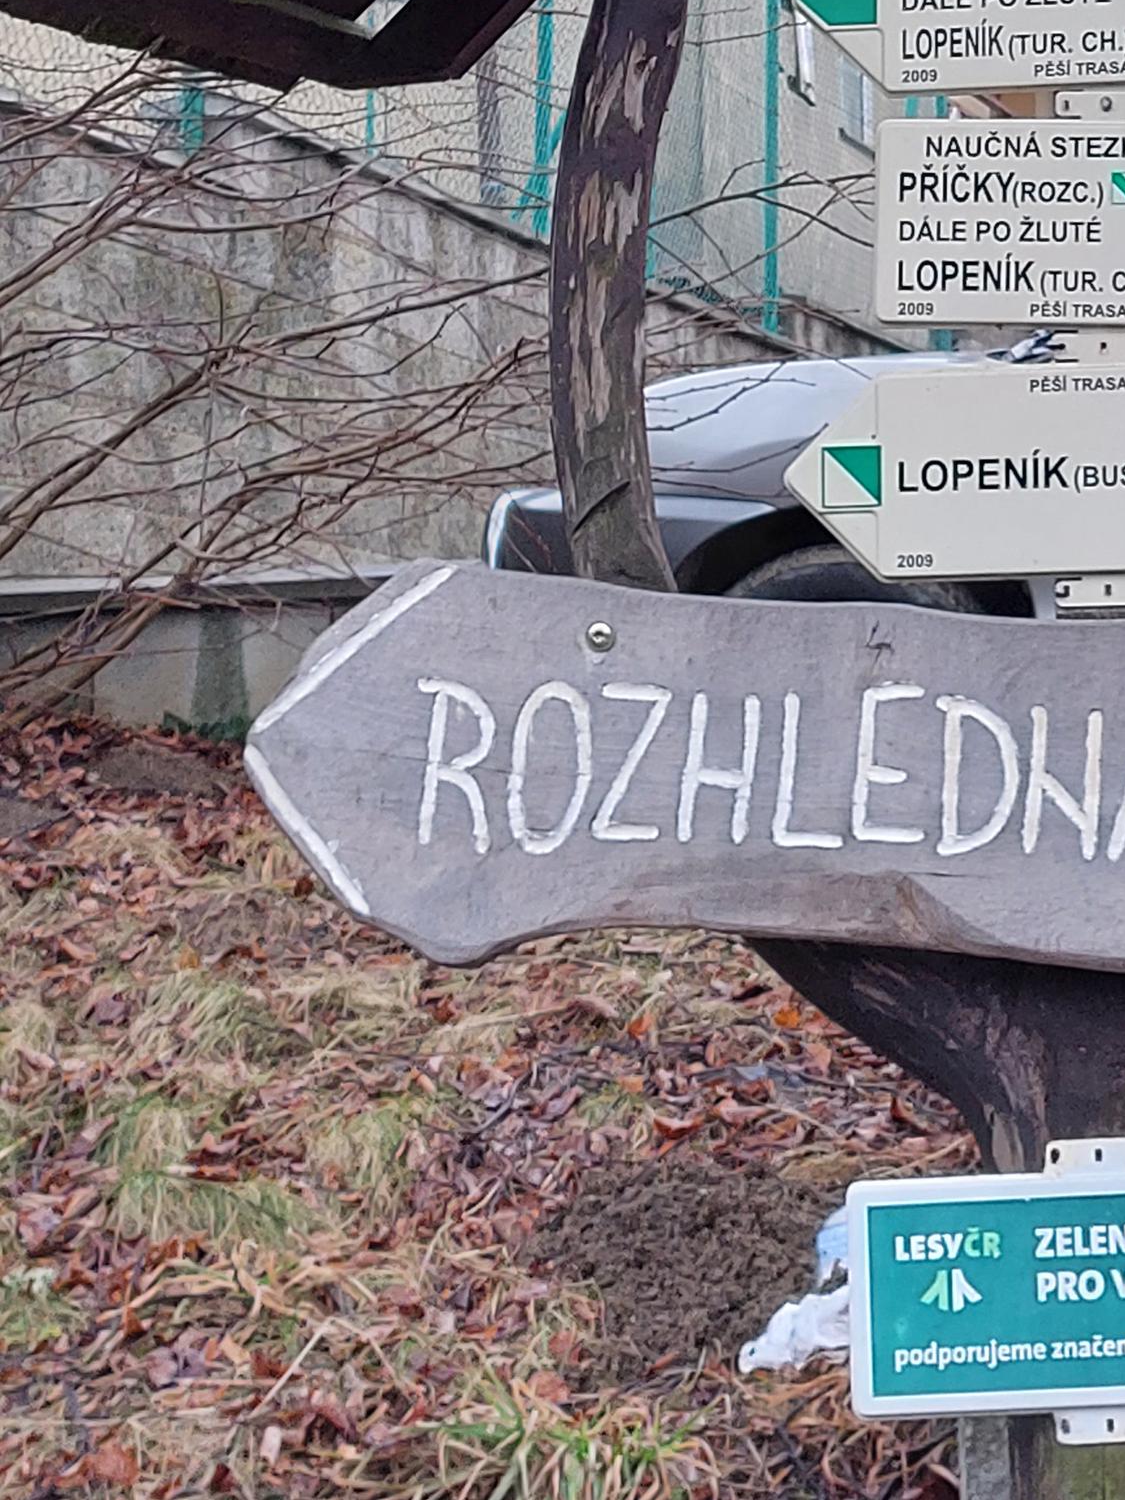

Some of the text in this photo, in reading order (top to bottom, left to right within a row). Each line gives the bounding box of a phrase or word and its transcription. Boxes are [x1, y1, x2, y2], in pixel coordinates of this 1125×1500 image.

[901, 19, 1004, 61] LOPENÍK
[1008, 33, 1073, 60] (TUR.
[902, 69, 938, 83] 2009
[1034, 60, 1070, 77] PĚŠÍ
[926, 132, 1042, 158] NAUČNÁ
[898, 164, 1013, 203] PŘÍČKY
[1012, 181, 1104, 208] (ROZC.)
[900, 214, 1101, 243] DÁLE PO ŽLUTÉ
[898, 252, 1033, 293] LOPENÍK
[1040, 270, 1105, 298] (TUR.
[898, 303, 933, 316] 2009
[1030, 301, 1068, 318] PĚŠÍ
[1030, 373, 1066, 393] PĚŠÍ
[898, 449, 1069, 492] LOPENÍK
[897, 554, 933, 568] 2009
[1037, 1271, 1104, 1302] PRO
[894, 1338, 1045, 1372] podporujeme
